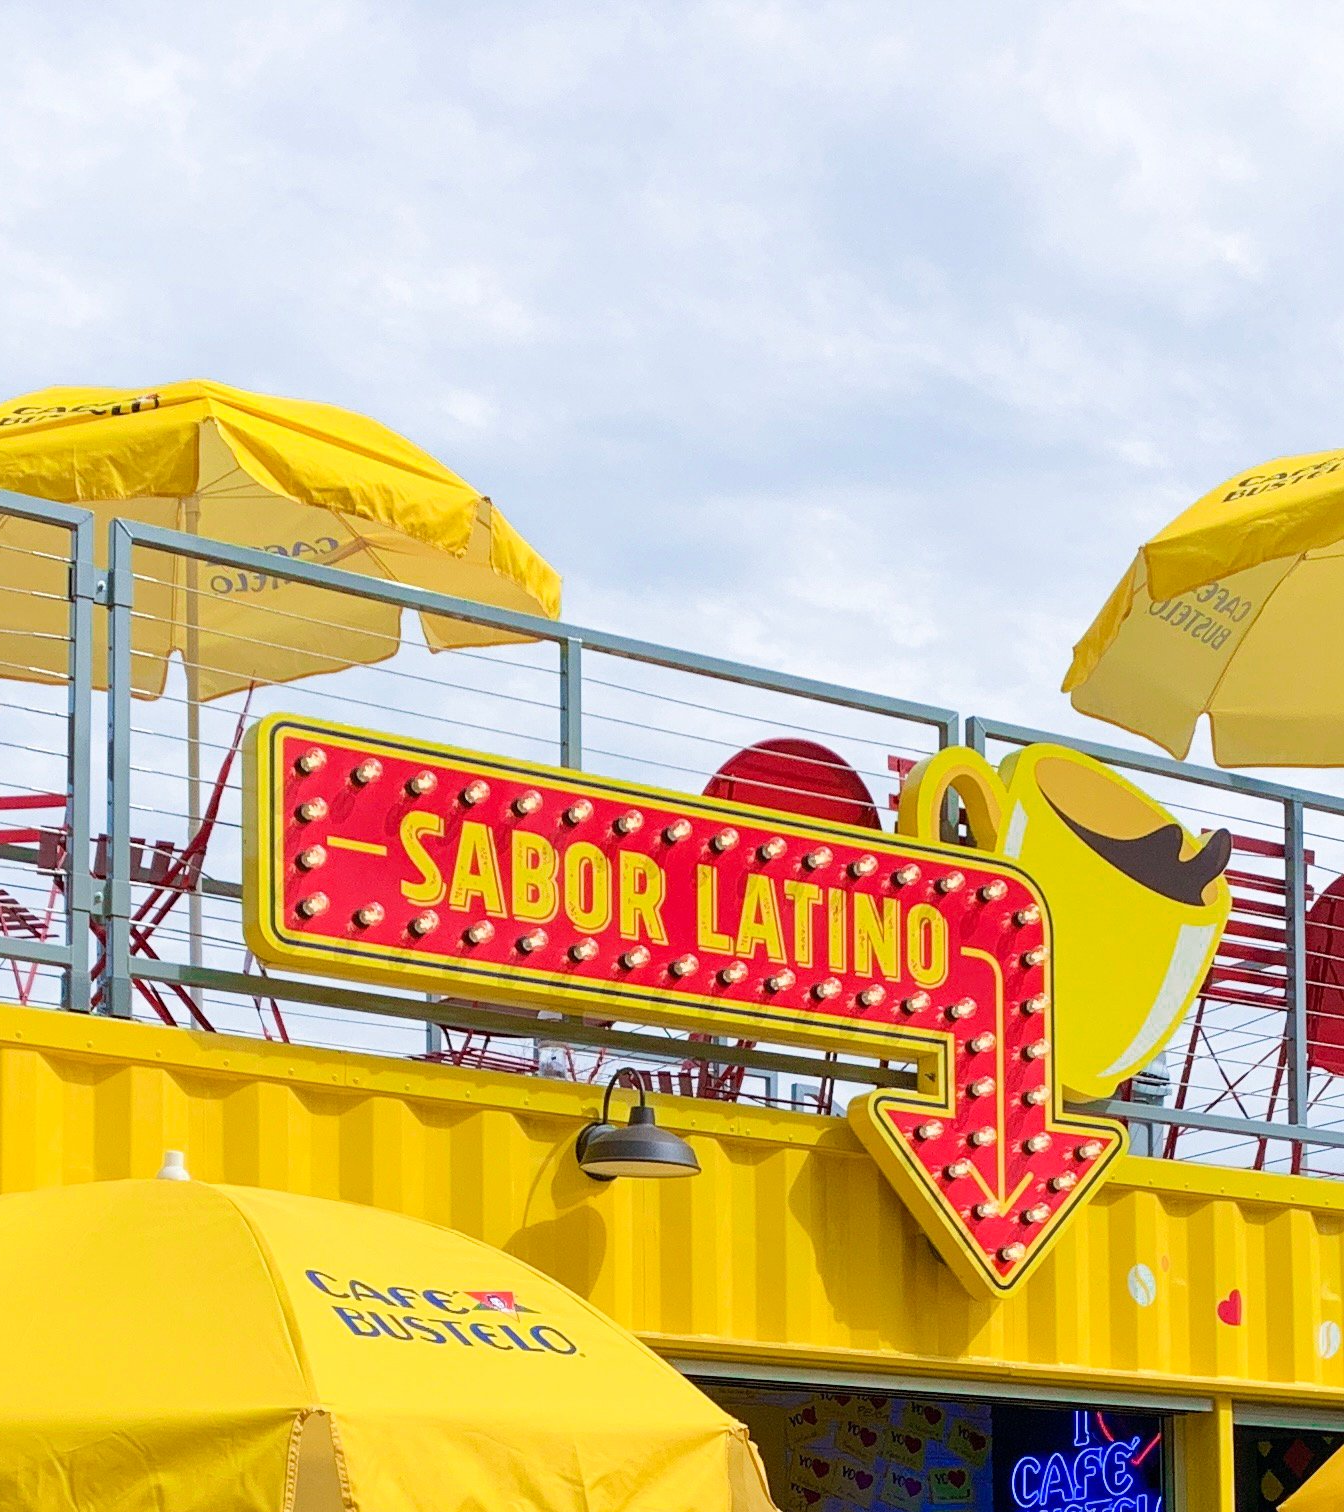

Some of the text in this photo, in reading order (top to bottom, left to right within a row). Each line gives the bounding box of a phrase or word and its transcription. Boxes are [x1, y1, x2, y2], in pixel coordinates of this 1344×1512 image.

[399, 809, 950, 989] SABOR LATINO
[331, 1305, 578, 1356] BUSTELO
[842, 1466, 856, 1480] YO
